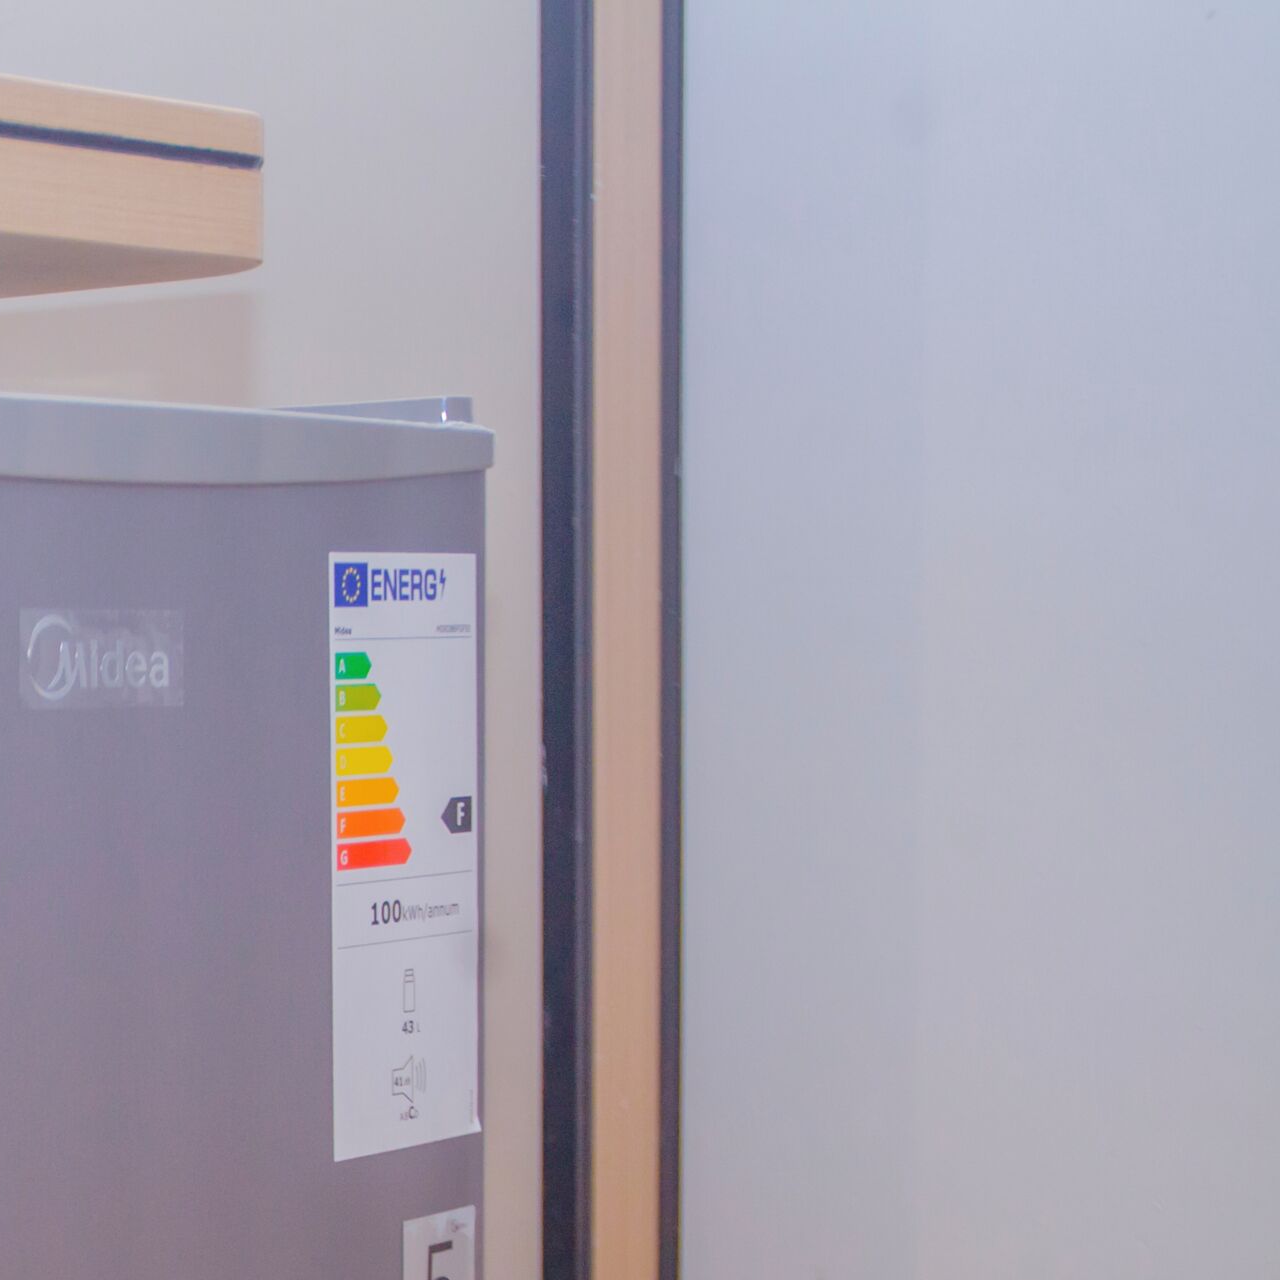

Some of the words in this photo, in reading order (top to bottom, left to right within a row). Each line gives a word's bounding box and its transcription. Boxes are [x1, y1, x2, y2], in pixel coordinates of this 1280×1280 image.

[371, 569, 437, 601] ENERG
[27, 614, 170, 700] Midea
[338, 658, 346, 674] A
[457, 802, 465, 826] F
[340, 850, 348, 866] G
[402, 1020, 414, 1034] 43
